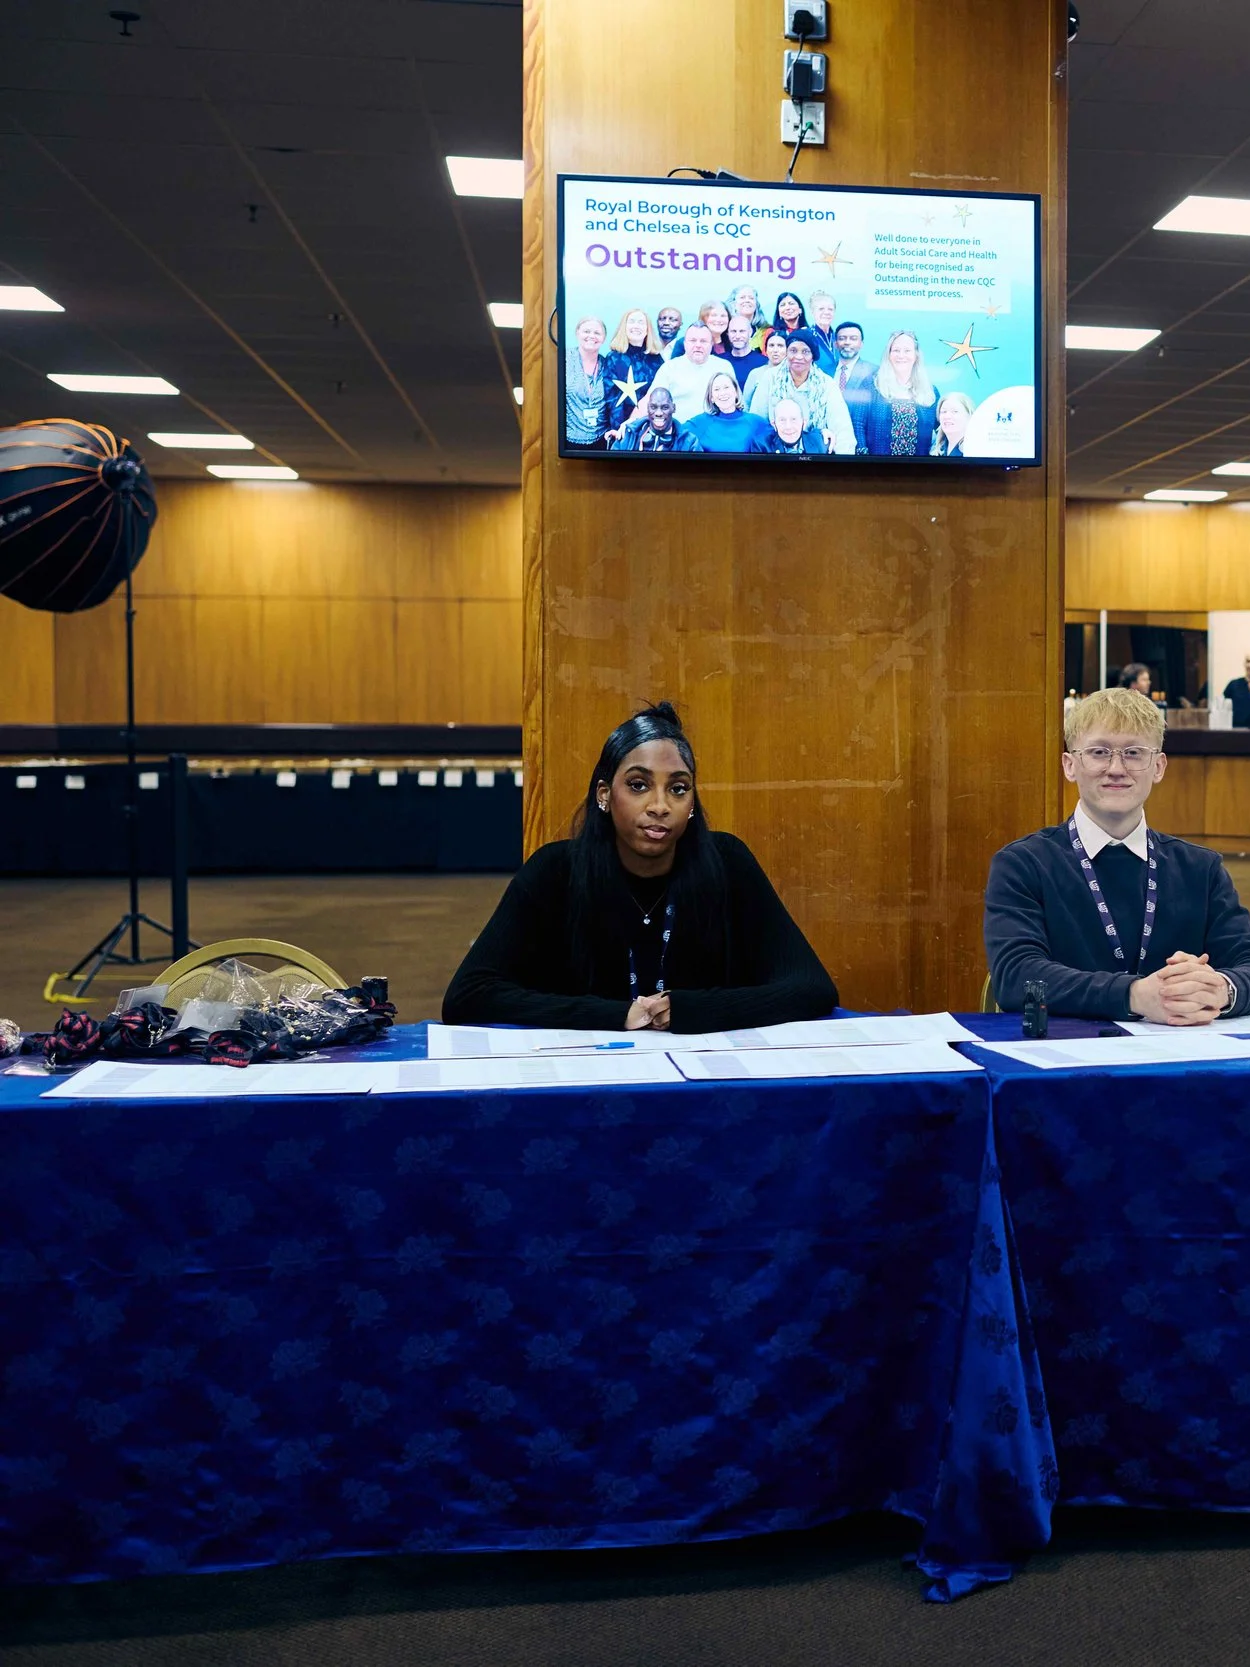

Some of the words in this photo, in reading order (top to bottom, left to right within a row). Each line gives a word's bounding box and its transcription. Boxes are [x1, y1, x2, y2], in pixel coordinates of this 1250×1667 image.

[585, 199, 632, 216] Royal
[638, 201, 712, 218] Borough
[717, 204, 735, 217] of
[739, 205, 836, 223] Kensington
[585, 219, 618, 231] and
[623, 219, 691, 234] Chelsea
[696, 221, 708, 235] is
[713, 223, 751, 239] CQC
[874, 234, 893, 242] Well
[895, 234, 918, 243] done
[919, 236, 929, 244] to
[930, 237, 971, 246] everyone
[972, 237, 981, 246] in
[874, 247, 898, 256] Adult
[900, 248, 926, 257] Social
[928, 249, 948, 258] Care
[950, 250, 966, 258] and
[968, 250, 997, 260] Health
[585, 243, 796, 280] Outstanding
[874, 260, 887, 269] for
[889, 260, 914, 271] being
[915, 262, 963, 272] recognised
[964, 264, 975, 272] as
[874, 273, 929, 285] Outstanding
[930, 275, 939, 284] in
[941, 276, 955, 284] the
[957, 277, 975, 285] new
[977, 277, 996, 287] CQC
[874, 288, 926, 297] assessment
[927, 289, 963, 298] process.
